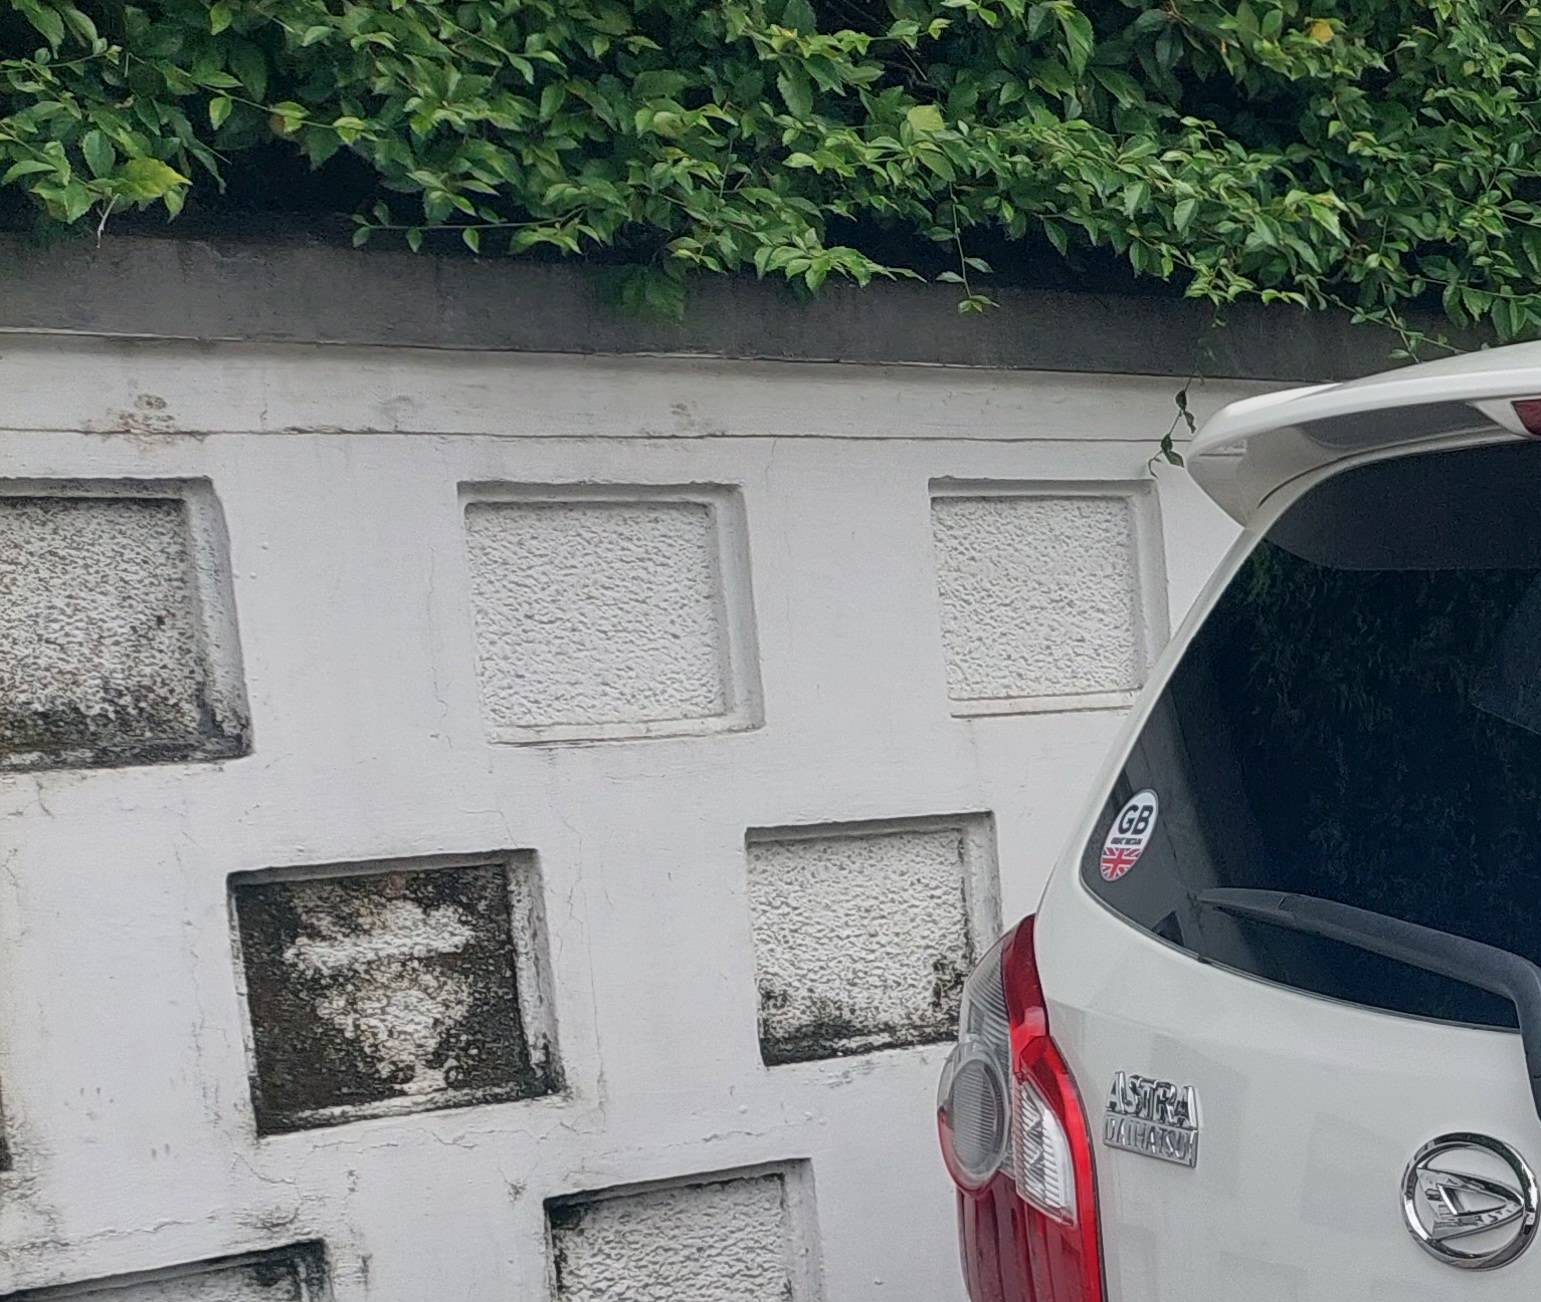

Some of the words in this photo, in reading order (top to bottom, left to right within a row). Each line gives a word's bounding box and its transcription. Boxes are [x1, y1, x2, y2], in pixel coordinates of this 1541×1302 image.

[1118, 803, 1154, 835] GB
[1105, 1071, 1198, 1130] ASTRA
[1104, 1116, 1198, 1166] DAIHATSU
